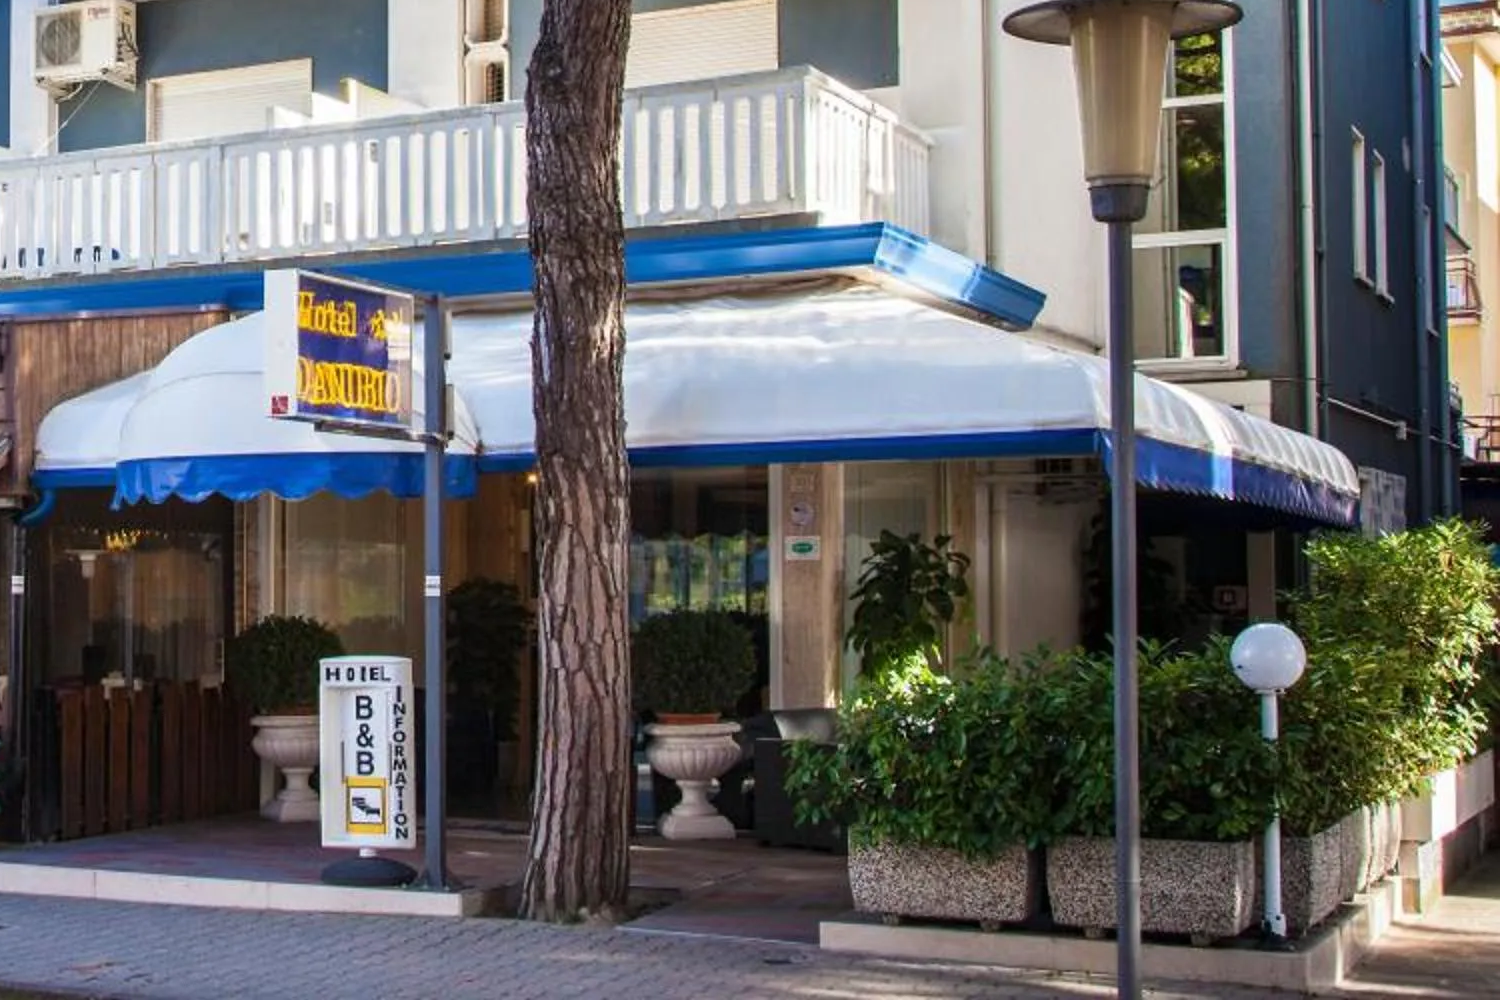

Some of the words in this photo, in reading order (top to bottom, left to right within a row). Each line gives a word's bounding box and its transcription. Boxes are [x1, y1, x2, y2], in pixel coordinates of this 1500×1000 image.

[297, 291, 358, 337] Hotel
[297, 356, 399, 413] DANUBIO
[326, 666, 391, 681] HOTEL
[393, 686, 409, 840] INFORMATION
